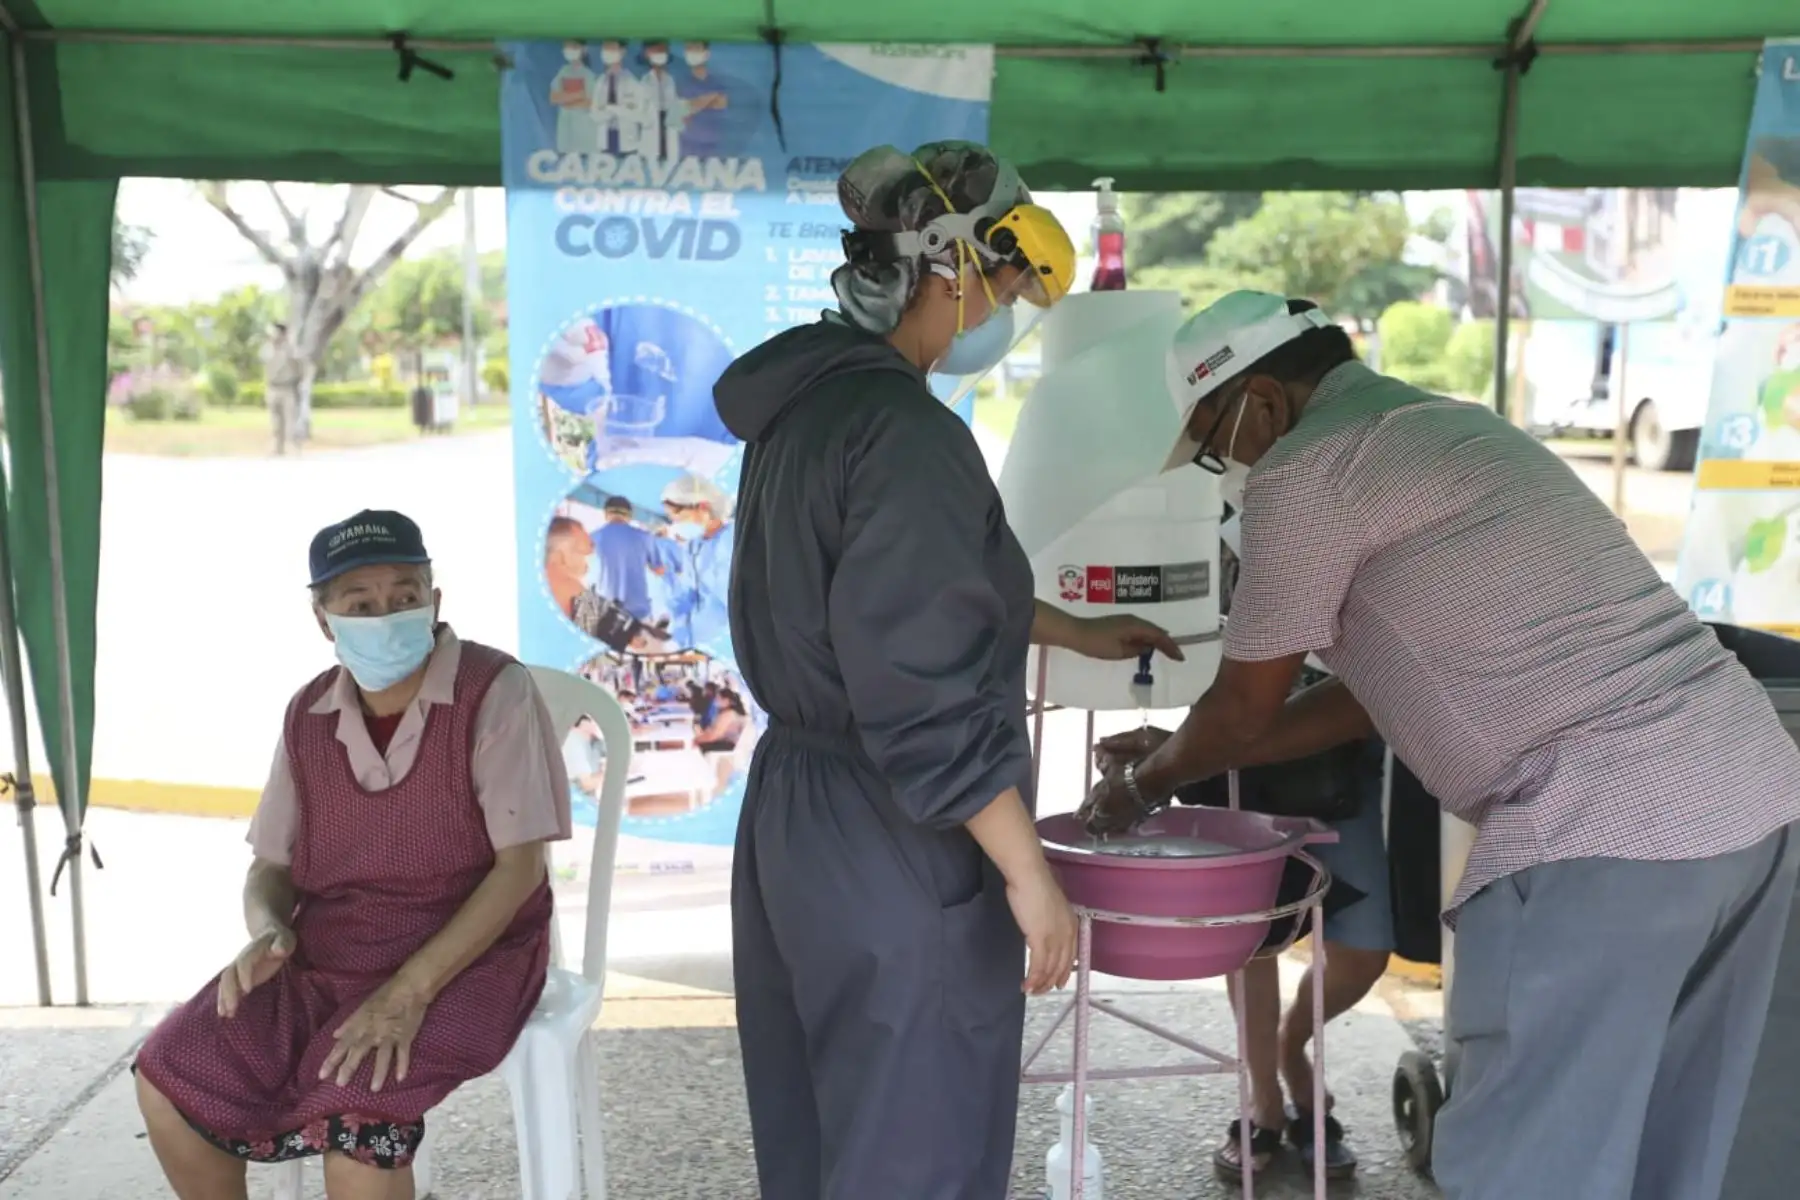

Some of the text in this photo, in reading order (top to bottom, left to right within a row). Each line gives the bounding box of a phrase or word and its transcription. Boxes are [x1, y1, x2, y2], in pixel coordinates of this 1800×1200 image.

[528, 150, 767, 191] CARAVANA
[555, 186, 741, 217] CONTRA EL
[555, 214, 742, 261] COVID
[768, 221, 793, 239] TE
[339, 524, 391, 541] YAMAHA
[1116, 573, 1159, 586] Ministerio
[1116, 586, 1128, 597] de
[1129, 585, 1152, 598] Salud
